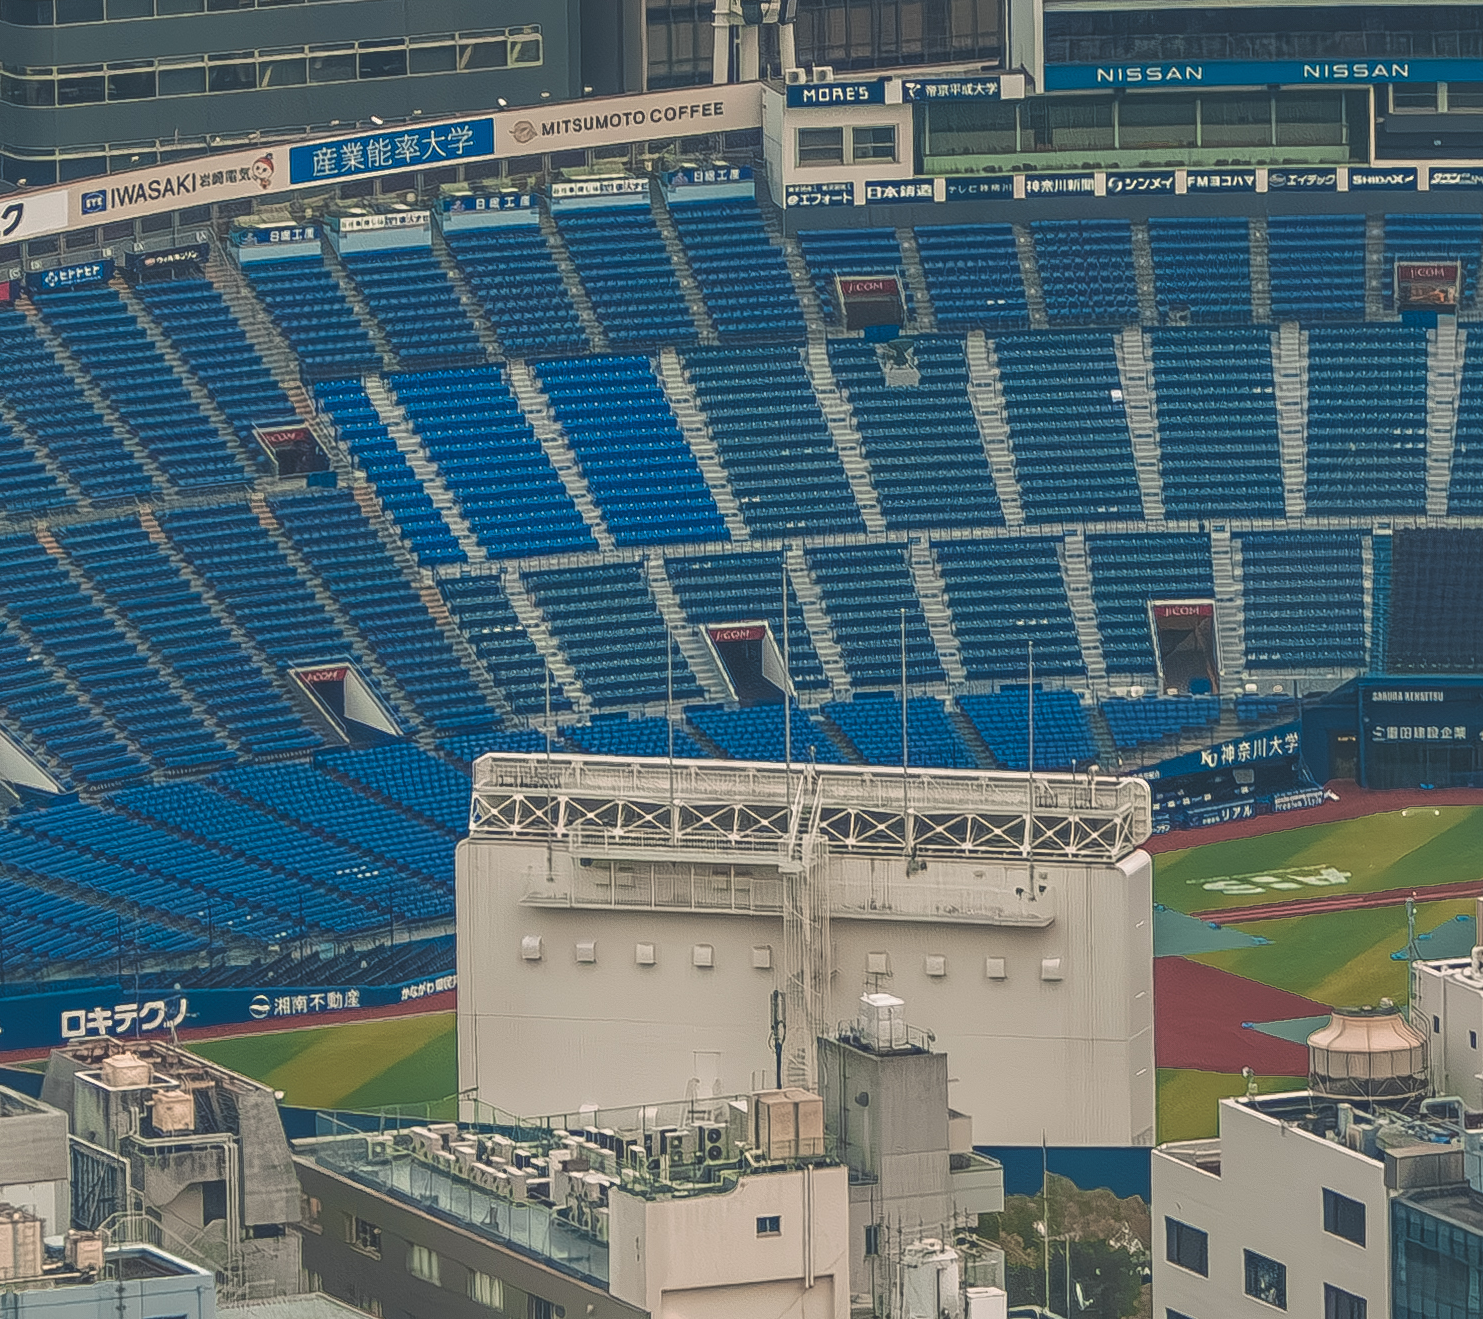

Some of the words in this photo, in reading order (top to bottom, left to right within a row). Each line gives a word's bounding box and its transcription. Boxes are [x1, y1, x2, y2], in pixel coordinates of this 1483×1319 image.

[1097, 66, 1204, 83] NISSAN
[1303, 63, 1409, 79] NISSAN
[802, 86, 869, 103] MORE'S
[540, 109, 646, 137] MITSUMOTO
[650, 101, 724, 124] COFFEE
[312, 125, 474, 178] 産業能率大学
[110, 172, 198, 209] IWASAKI
[1220, 731, 1299, 765] 神奈川大学
[274, 990, 360, 1016] 湘南不動産
